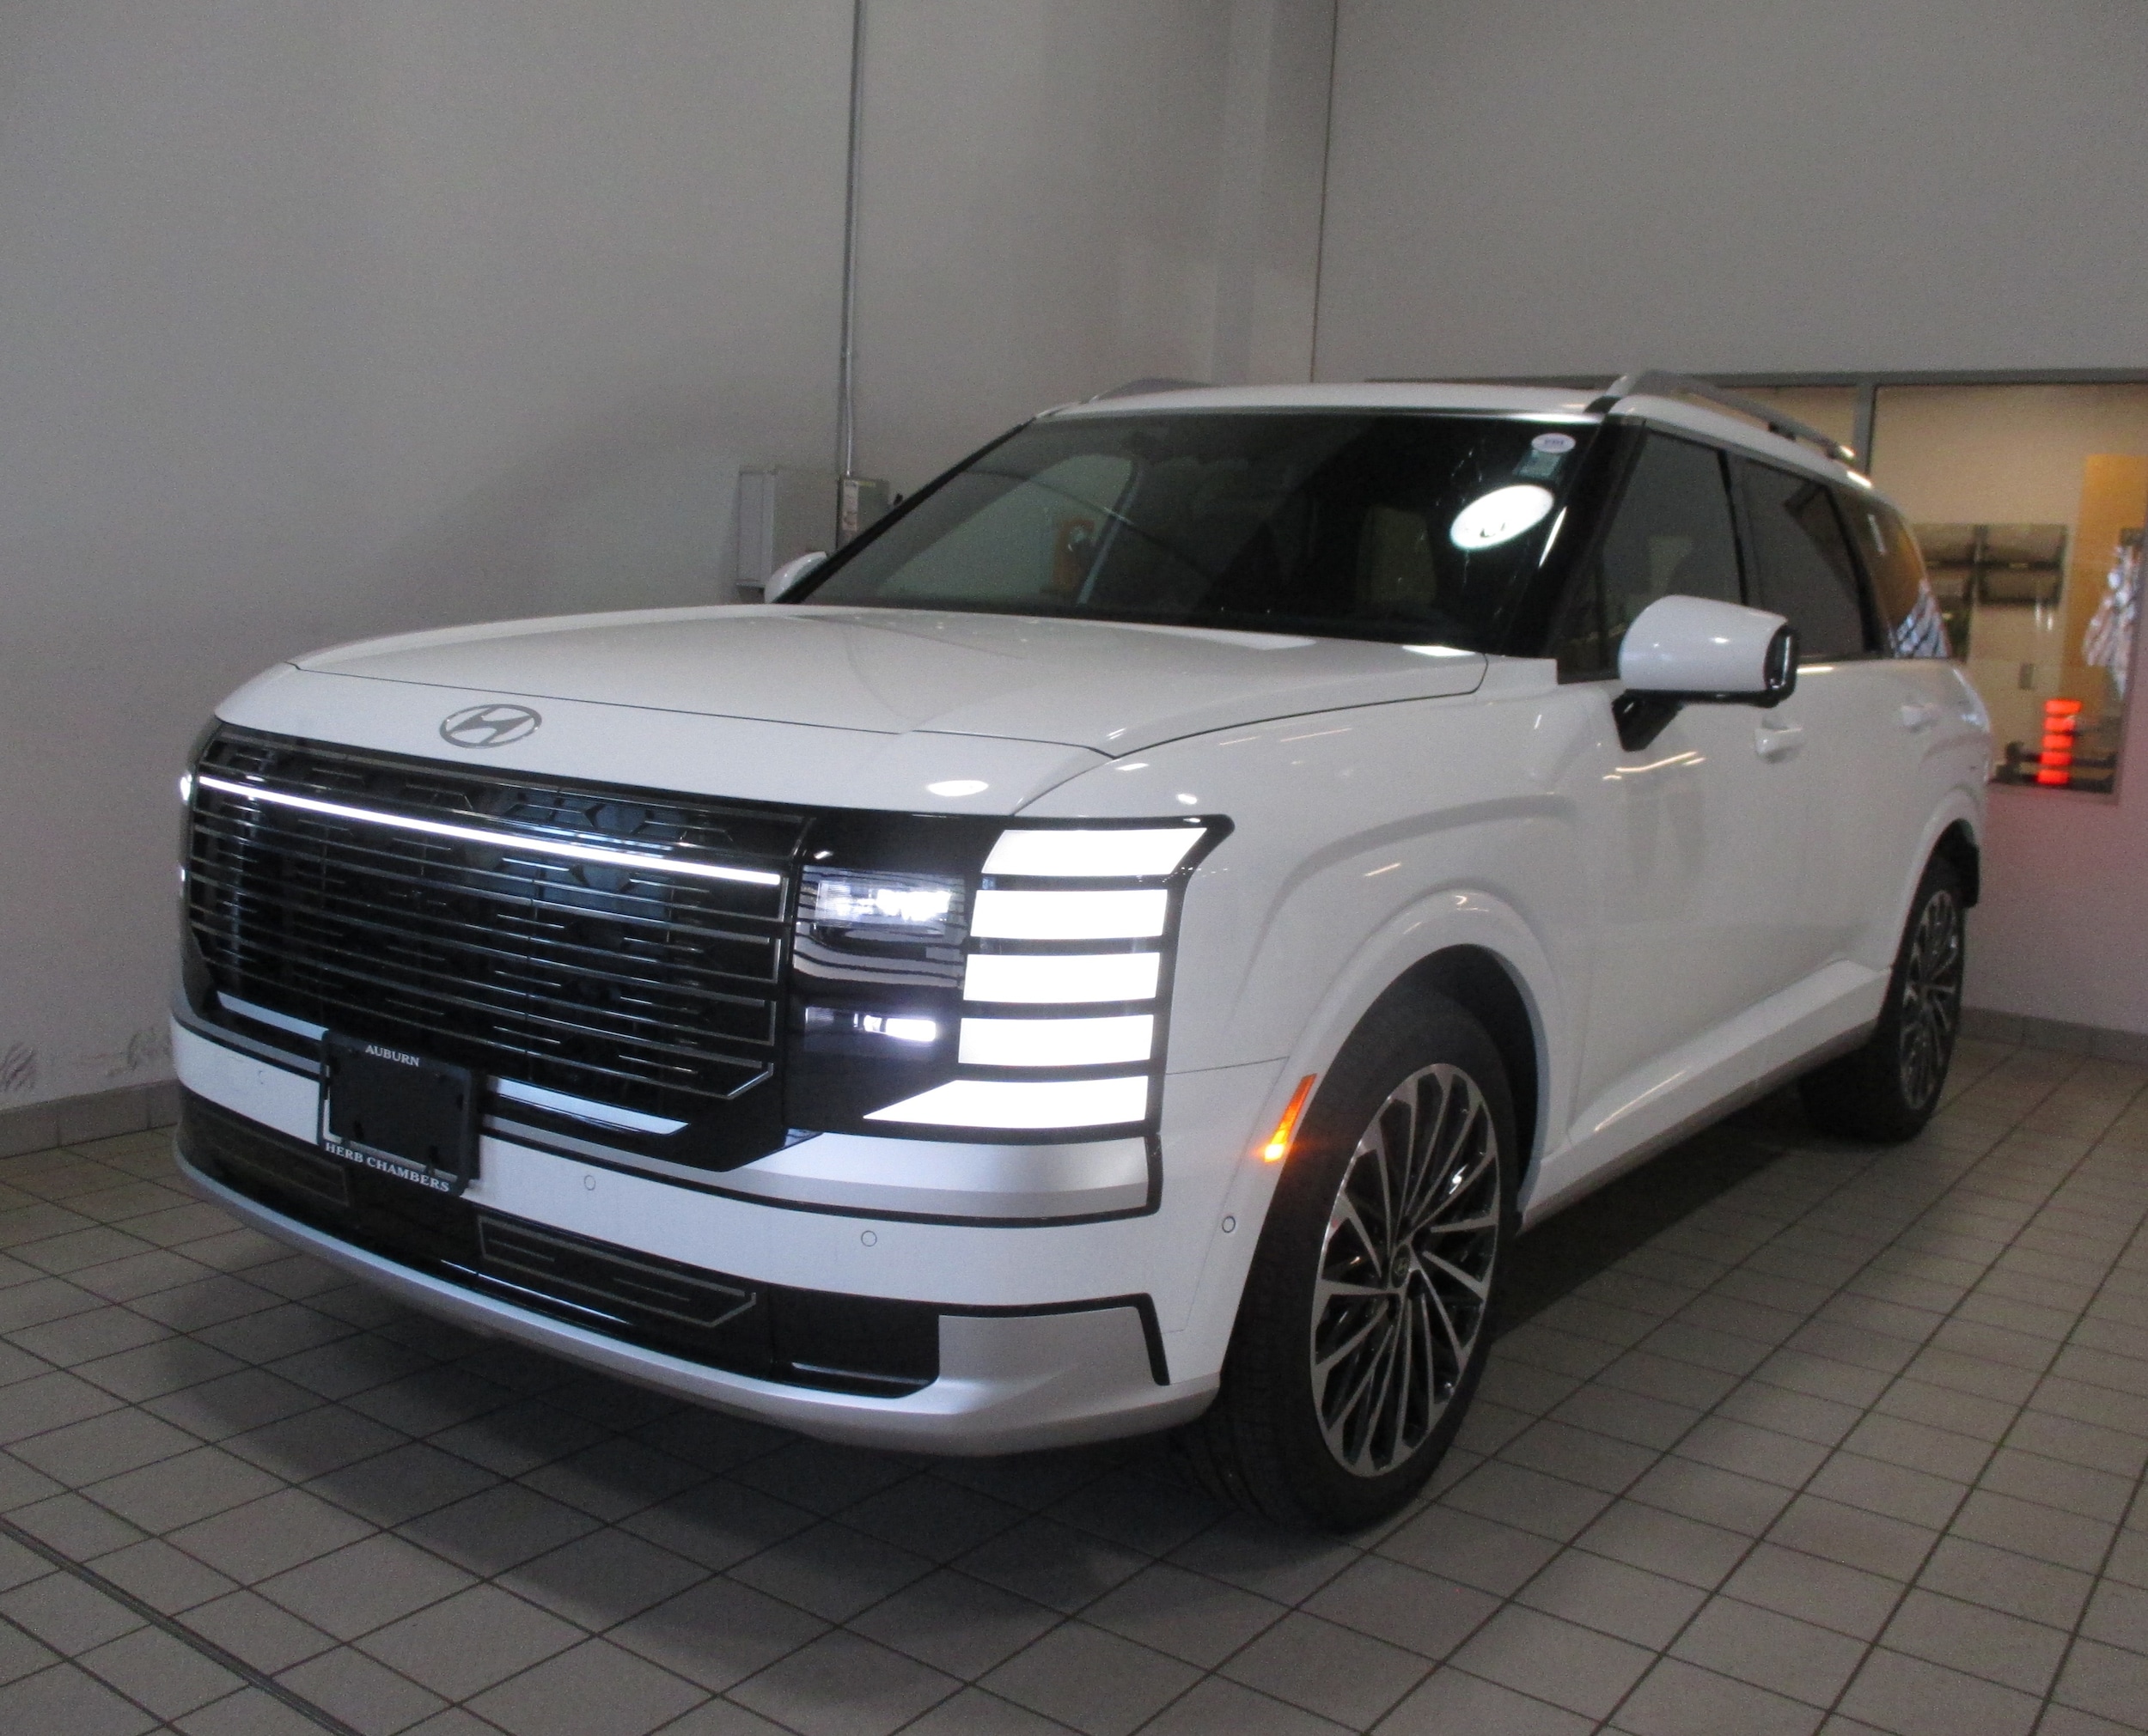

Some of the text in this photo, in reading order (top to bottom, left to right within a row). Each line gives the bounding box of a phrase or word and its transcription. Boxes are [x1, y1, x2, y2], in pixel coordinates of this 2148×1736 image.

[365, 1045, 420, 1067] AUBURN
[325, 1142, 450, 1192] HERB CHAMBERS
